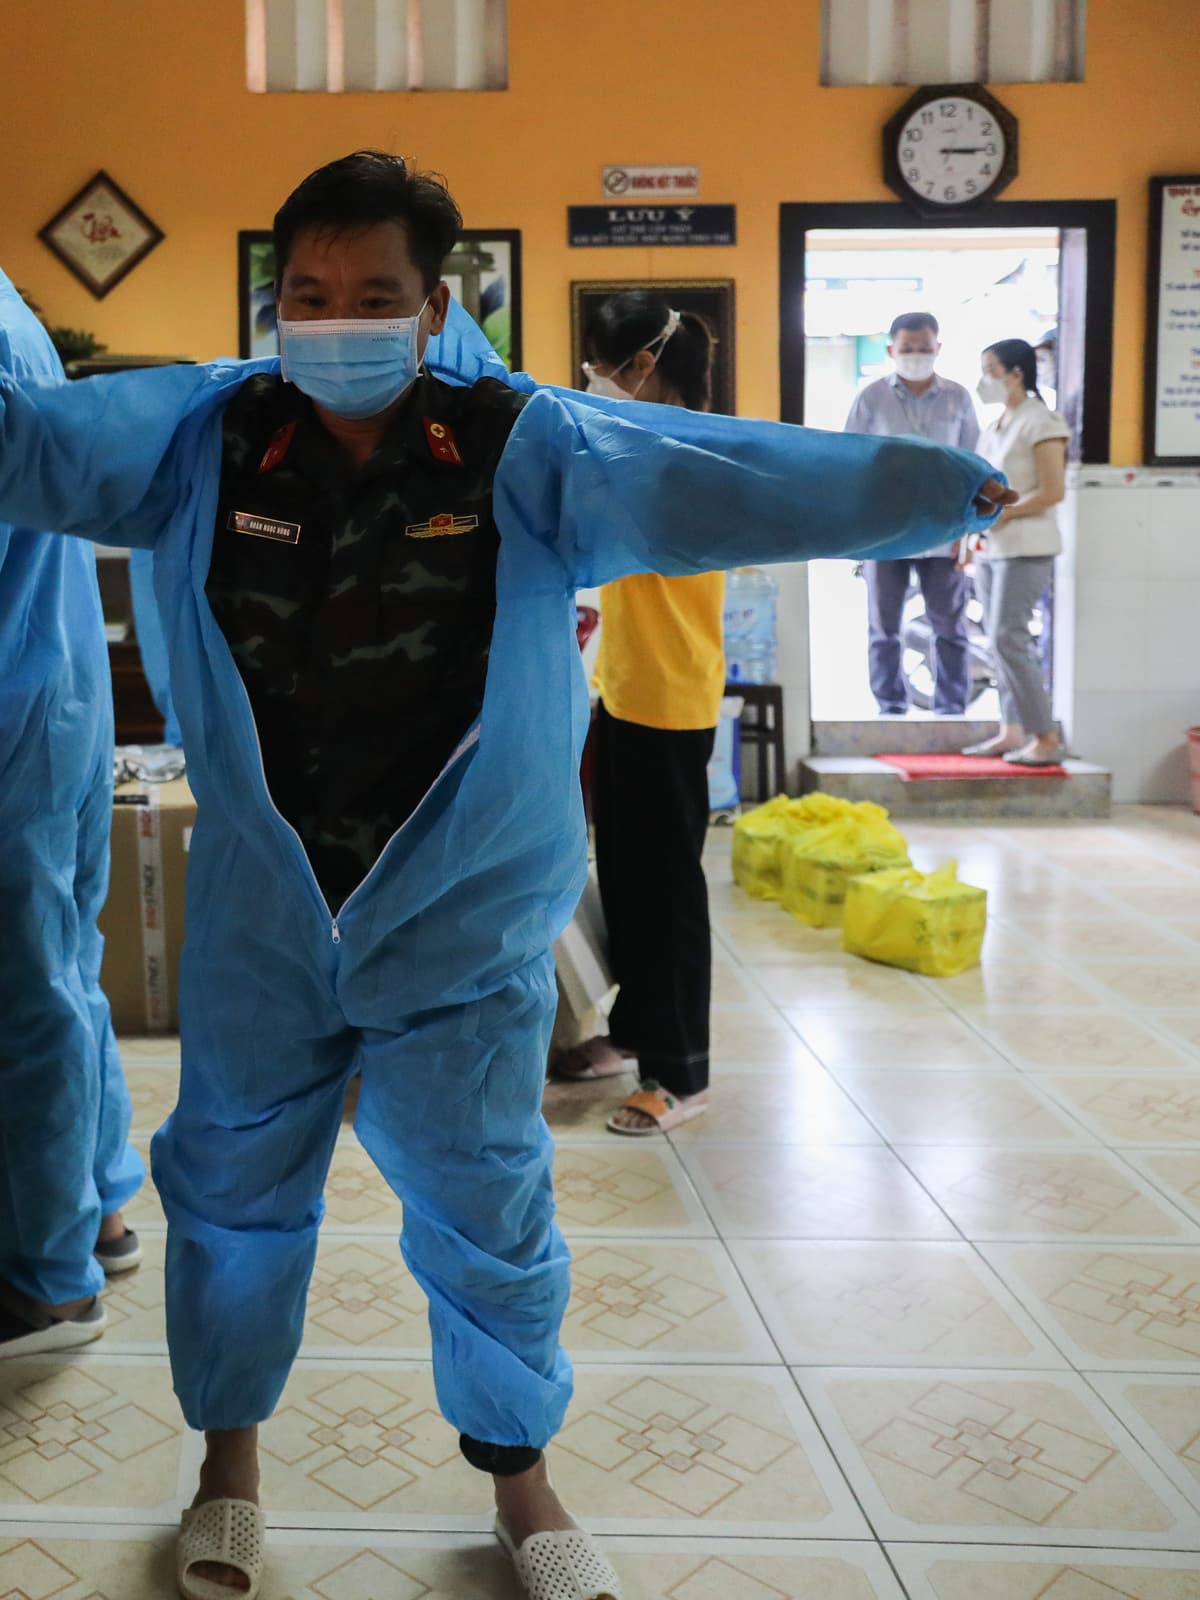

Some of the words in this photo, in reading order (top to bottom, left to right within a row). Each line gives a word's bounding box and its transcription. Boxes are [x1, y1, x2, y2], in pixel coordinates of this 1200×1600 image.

[921, 111, 933, 124] 11
[940, 103, 957, 118] 12
[967, 106, 973, 121] 1
[905, 127, 922, 142] 10
[981, 121, 992, 136] 2
[902, 147, 914, 162] 9
[985, 142, 996, 156] 3
[908, 168, 919, 182] 8
[980, 163, 991, 175] 4
[925, 181, 935, 194] 7
[943, 186, 956, 200] 6
[965, 180, 976, 194] 5
